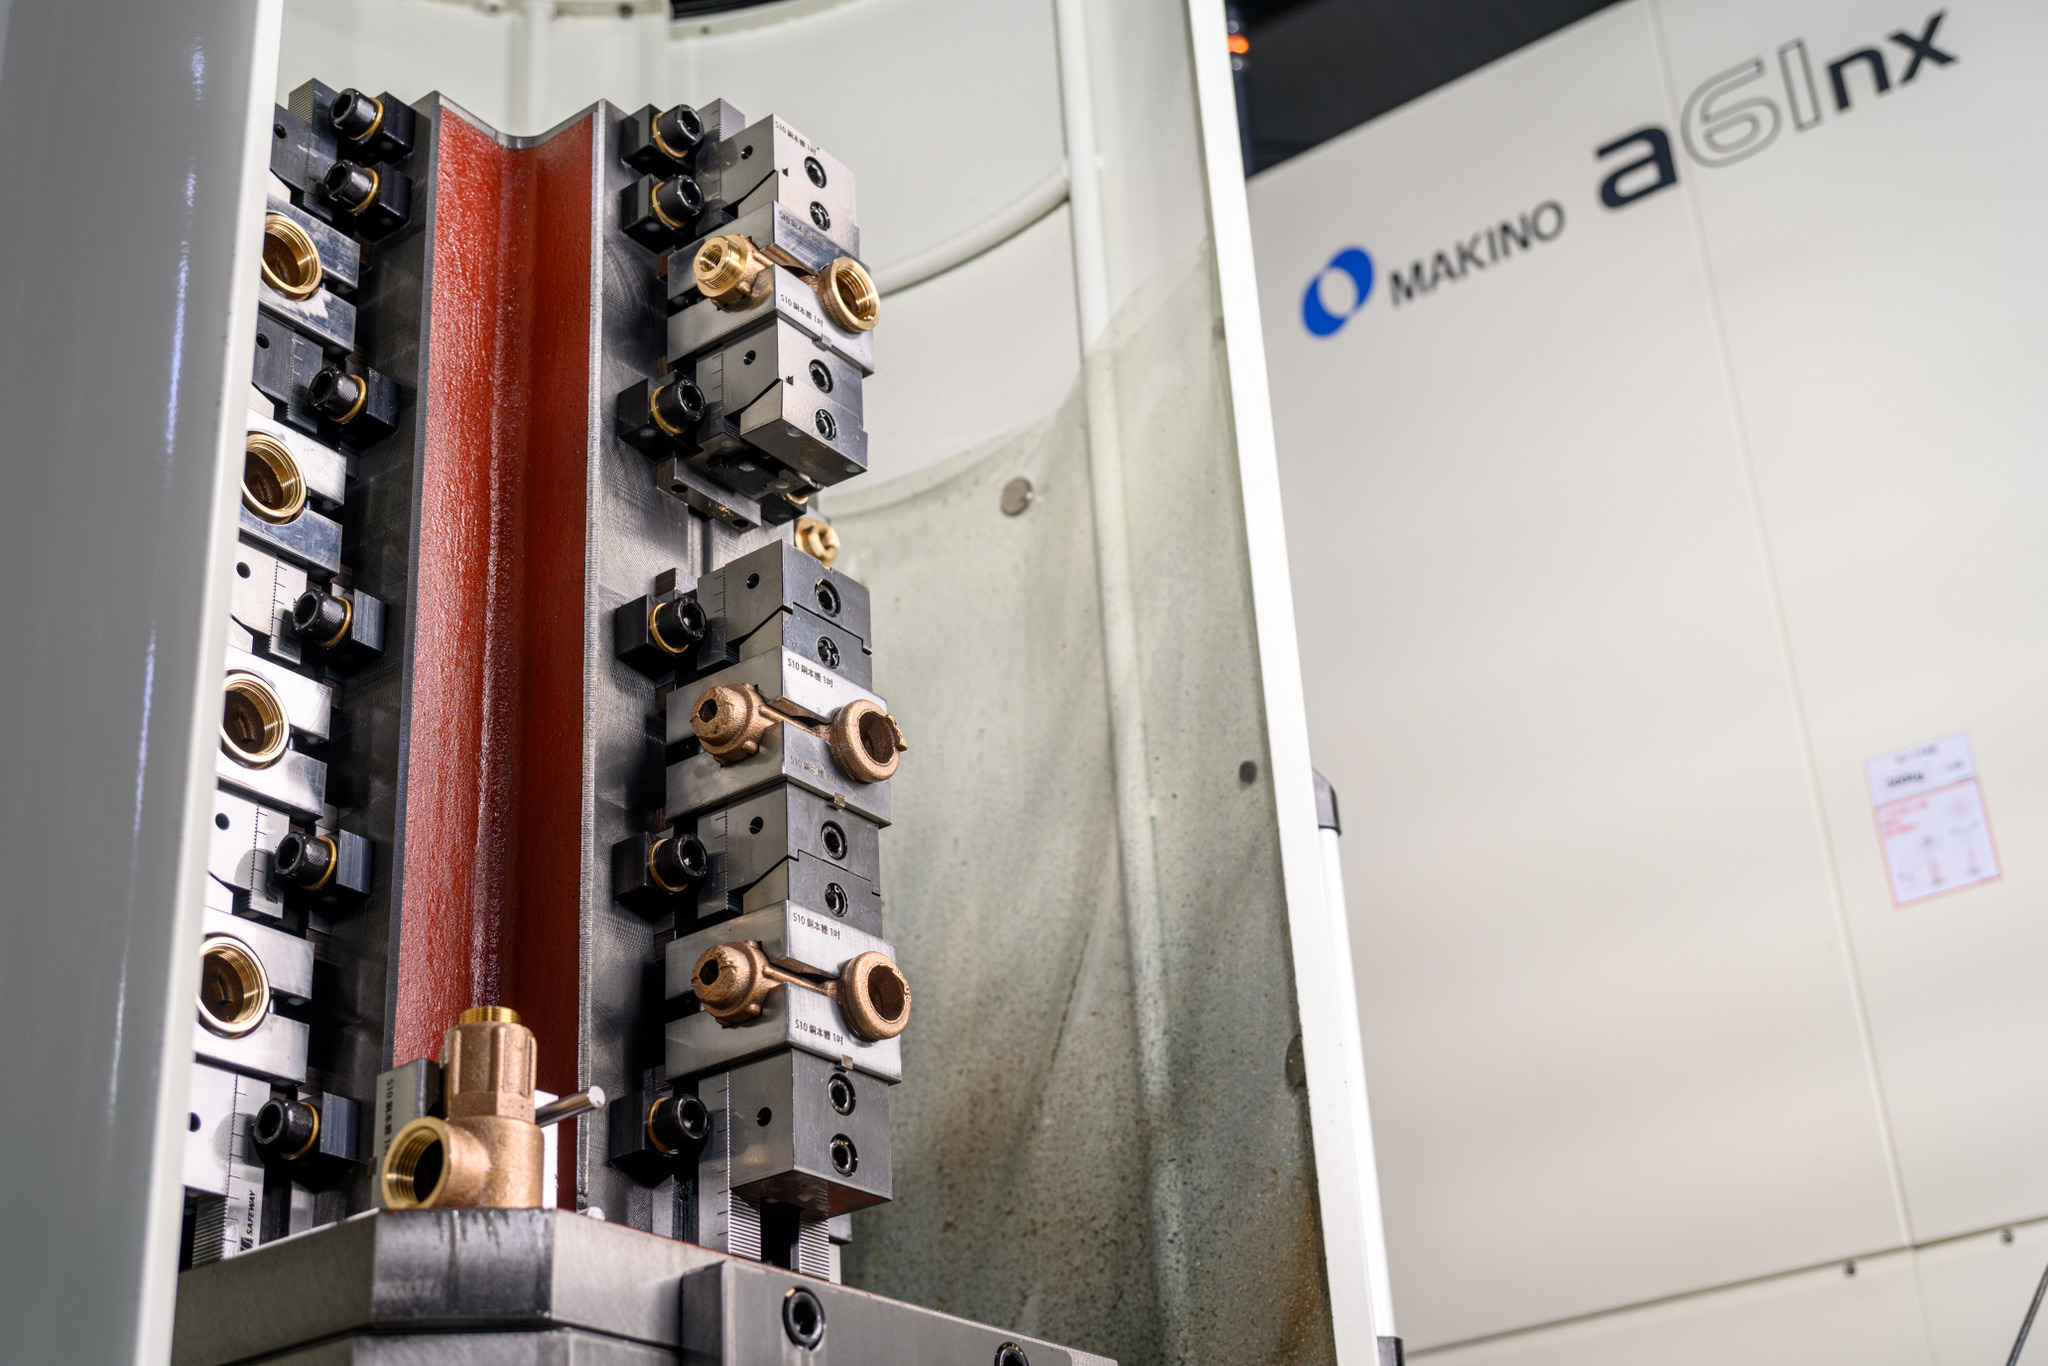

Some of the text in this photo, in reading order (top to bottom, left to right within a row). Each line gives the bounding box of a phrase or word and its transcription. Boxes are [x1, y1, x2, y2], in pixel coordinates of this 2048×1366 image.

[775, 121, 786, 134] S10
[1390, 199, 1566, 308] MAKINO
[780, 294, 792, 306] S10
[787, 658, 799, 671] S10
[793, 912, 805, 925] S10
[795, 1019, 808, 1032] S10
[246, 1189, 256, 1236] SAFEWAY
